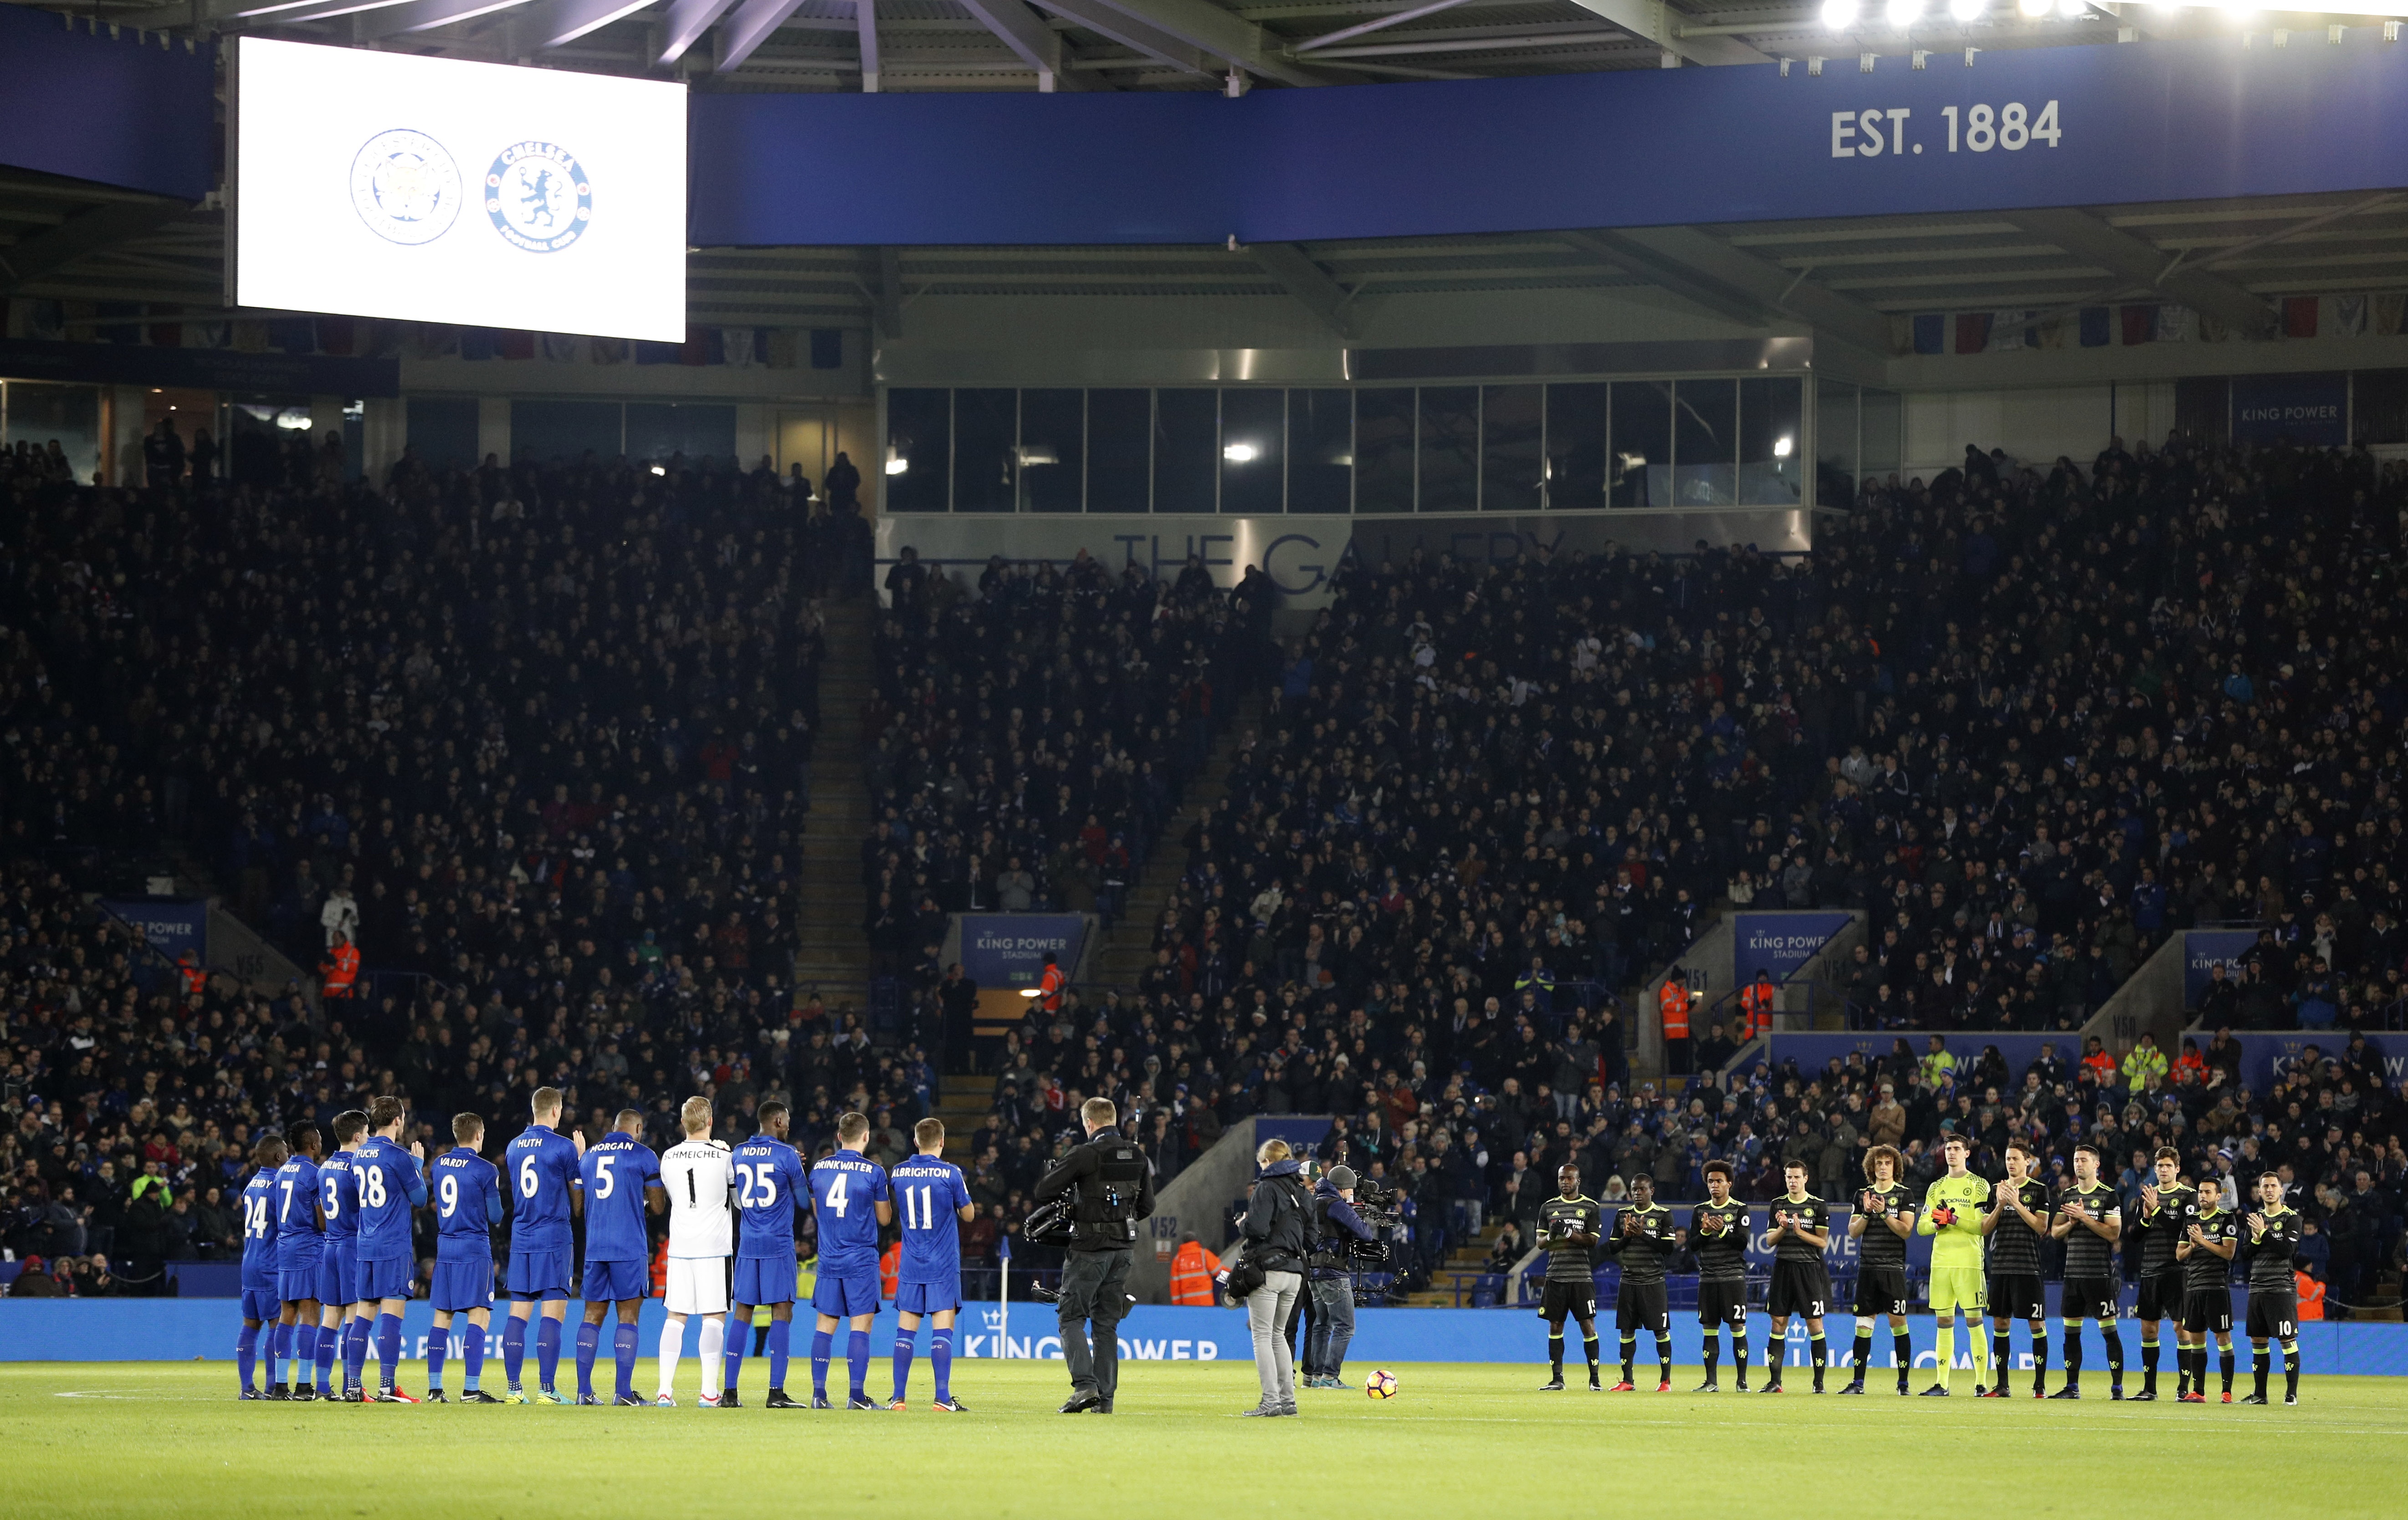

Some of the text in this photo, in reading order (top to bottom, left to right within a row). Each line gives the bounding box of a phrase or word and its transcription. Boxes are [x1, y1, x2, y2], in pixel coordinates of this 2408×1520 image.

[1832, 100, 2061, 158] EST. 1884
[501, 142, 574, 172] CHELSEA
[2241, 405, 2337, 421] KING POWER
[148, 922, 192, 935] POWER
[977, 938, 1067, 950] KING POWER
[1750, 937, 1783, 949] KING
[1773, 950, 1810, 959] STADIUM
[2113, 1015, 2136, 1038] V50
[517, 1138, 543, 1148] HUTH
[589, 1141, 634, 1154] MORGAN
[356, 1148, 380, 1159] FUCHS
[664, 1150, 722, 1160] SCHMEICHEL
[742, 1146, 772, 1157] NDIDI
[281, 1163, 301, 1173] MUSA
[440, 1157, 469, 1168] VARDY
[813, 1160, 873, 1174] DRINKWATER
[520, 1154, 539, 1199] 6
[594, 1155, 615, 1200] 5
[891, 1167, 951, 1179] ALBRIGHTON
[353, 1164, 387, 1208] 28
[687, 1167, 696, 1208] 1
[736, 1163, 777, 1208] 25
[280, 1180, 294, 1223] 7
[324, 1177, 340, 1220] 3
[440, 1174, 458, 1218] 9
[825, 1172, 849, 1218] 4
[905, 1184, 933, 1230] 11
[244, 1195, 268, 1239] 24
[1150, 1217, 1177, 1238] V52
[1733, 1305, 1746, 1320] 22
[1812, 1300, 1825, 1316] 28
[1892, 1299, 1906, 1315] 30
[2031, 1303, 2043, 1319] 21
[2100, 1300, 2117, 1316] 24
[1661, 1312, 1668, 1328] 7
[2220, 1314, 2229, 1329] 11
[2278, 1320, 2292, 1336] 10
